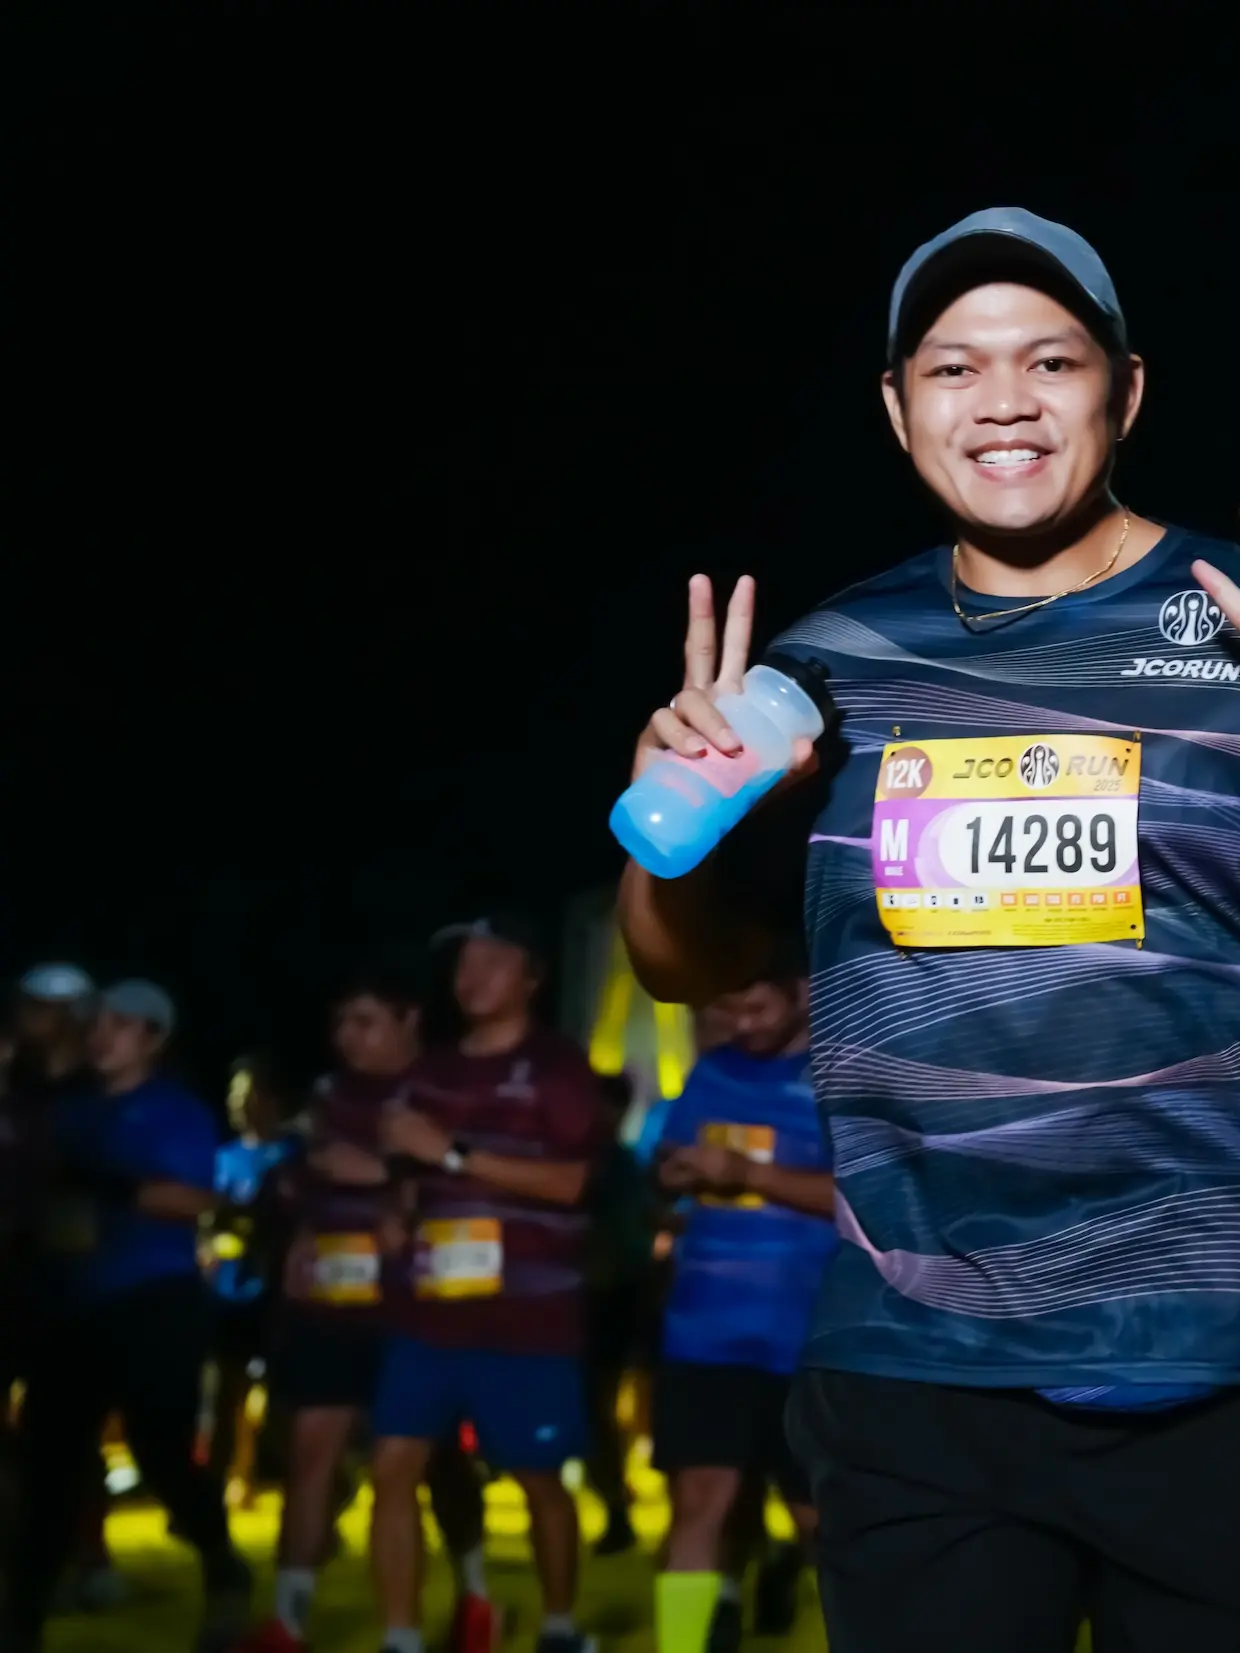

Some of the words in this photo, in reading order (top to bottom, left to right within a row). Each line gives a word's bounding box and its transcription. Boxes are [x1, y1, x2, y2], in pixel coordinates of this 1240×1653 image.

[886, 758, 925, 789] 12K
[953, 758, 1014, 779] JCO
[1066, 755, 1129, 776] RUN
[1094, 779, 1121, 792] 2025
[880, 819, 910, 862] M
[966, 814, 1116, 874] 14289
